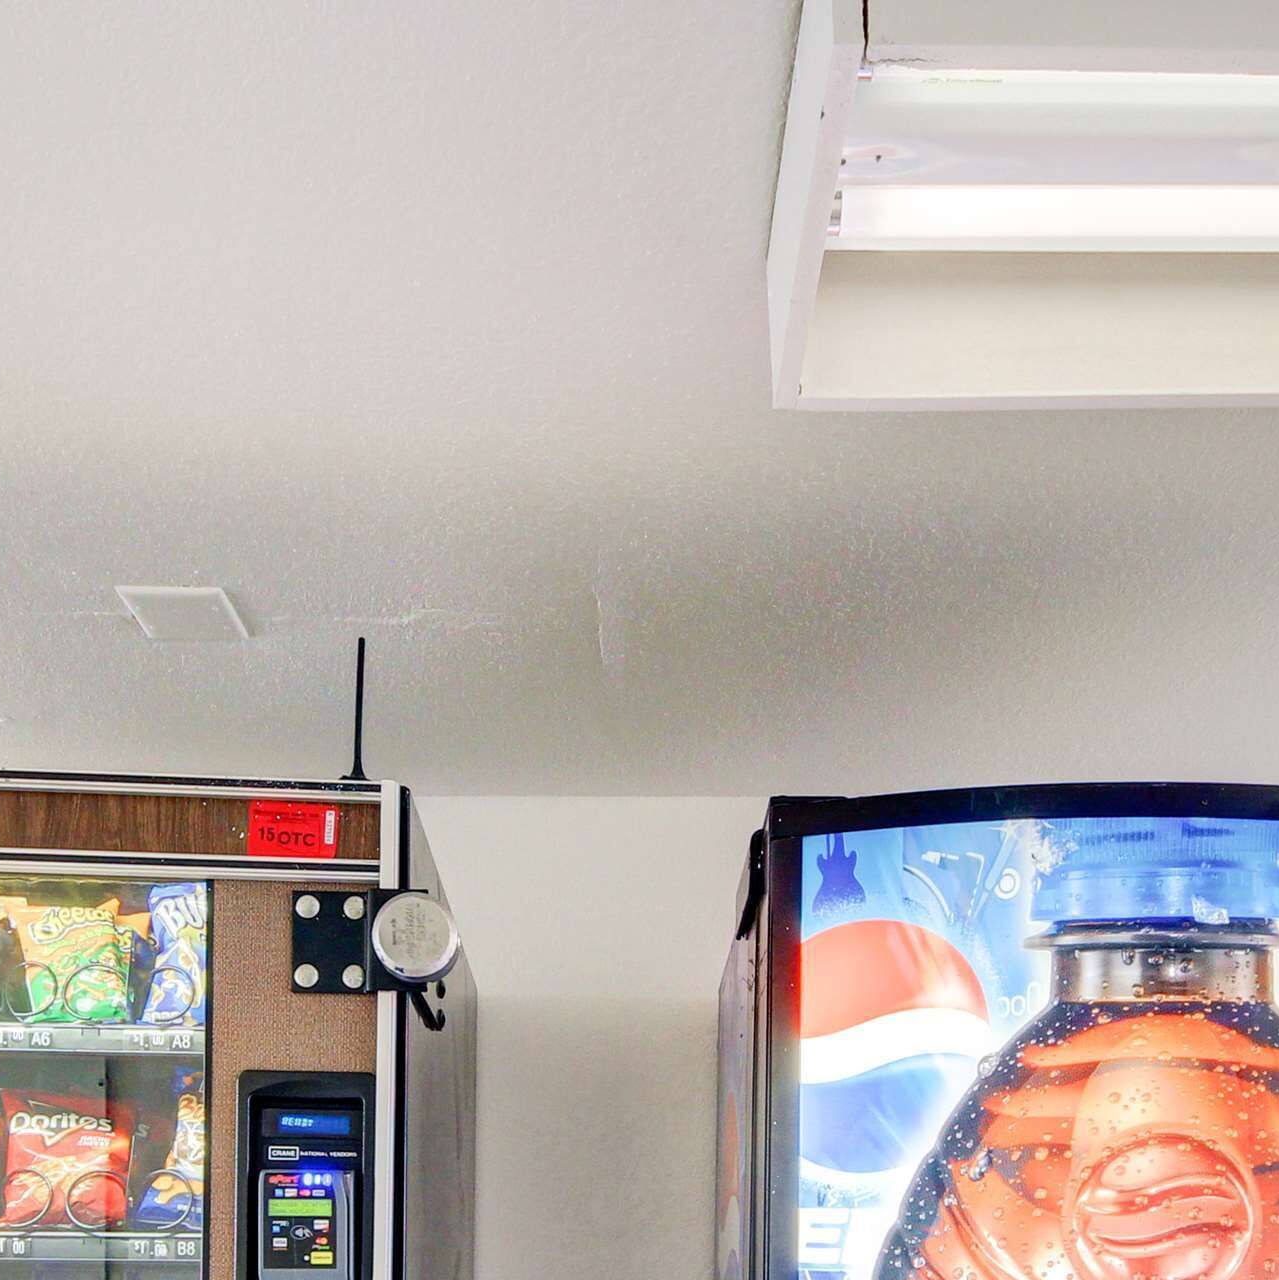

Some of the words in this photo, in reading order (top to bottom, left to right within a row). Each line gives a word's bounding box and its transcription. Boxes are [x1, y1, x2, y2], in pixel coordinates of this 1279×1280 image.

[277, 831, 316, 847] OTC
[31, 1032, 51, 1046] A6
[172, 1034, 191, 1049] A8
[9, 1112, 113, 1137] Doritos
[271, 1149, 296, 1157] CRANE
[177, 1241, 196, 1256] B8
